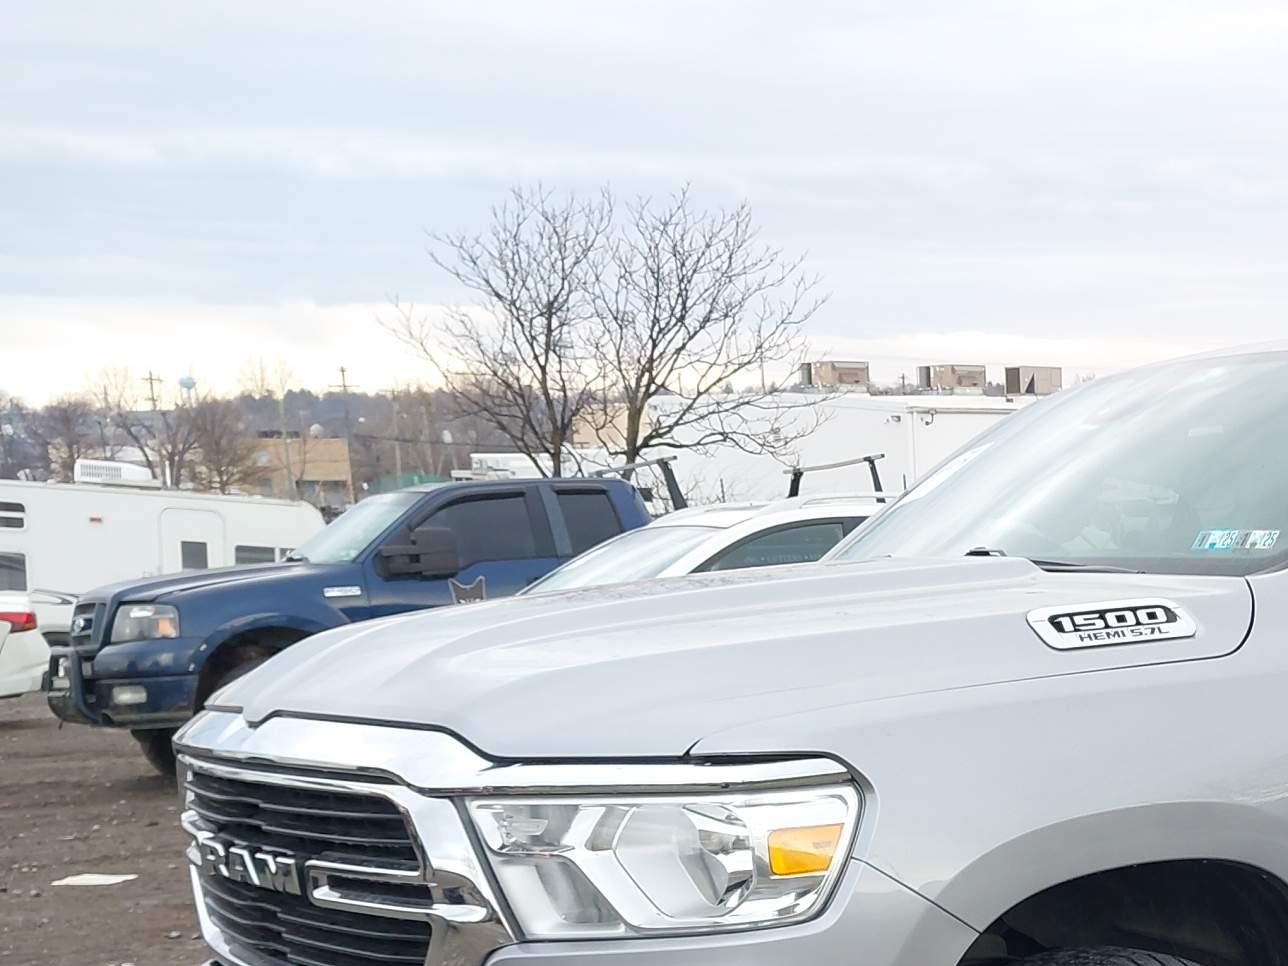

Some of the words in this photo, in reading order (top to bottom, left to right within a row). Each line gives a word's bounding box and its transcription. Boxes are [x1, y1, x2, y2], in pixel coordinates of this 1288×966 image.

[1053, 606, 1168, 633] 1500
[1078, 629, 1127, 642] HEMI
[1131, 626, 1170, 637] 5.7L
[197, 838, 302, 896] RAM
